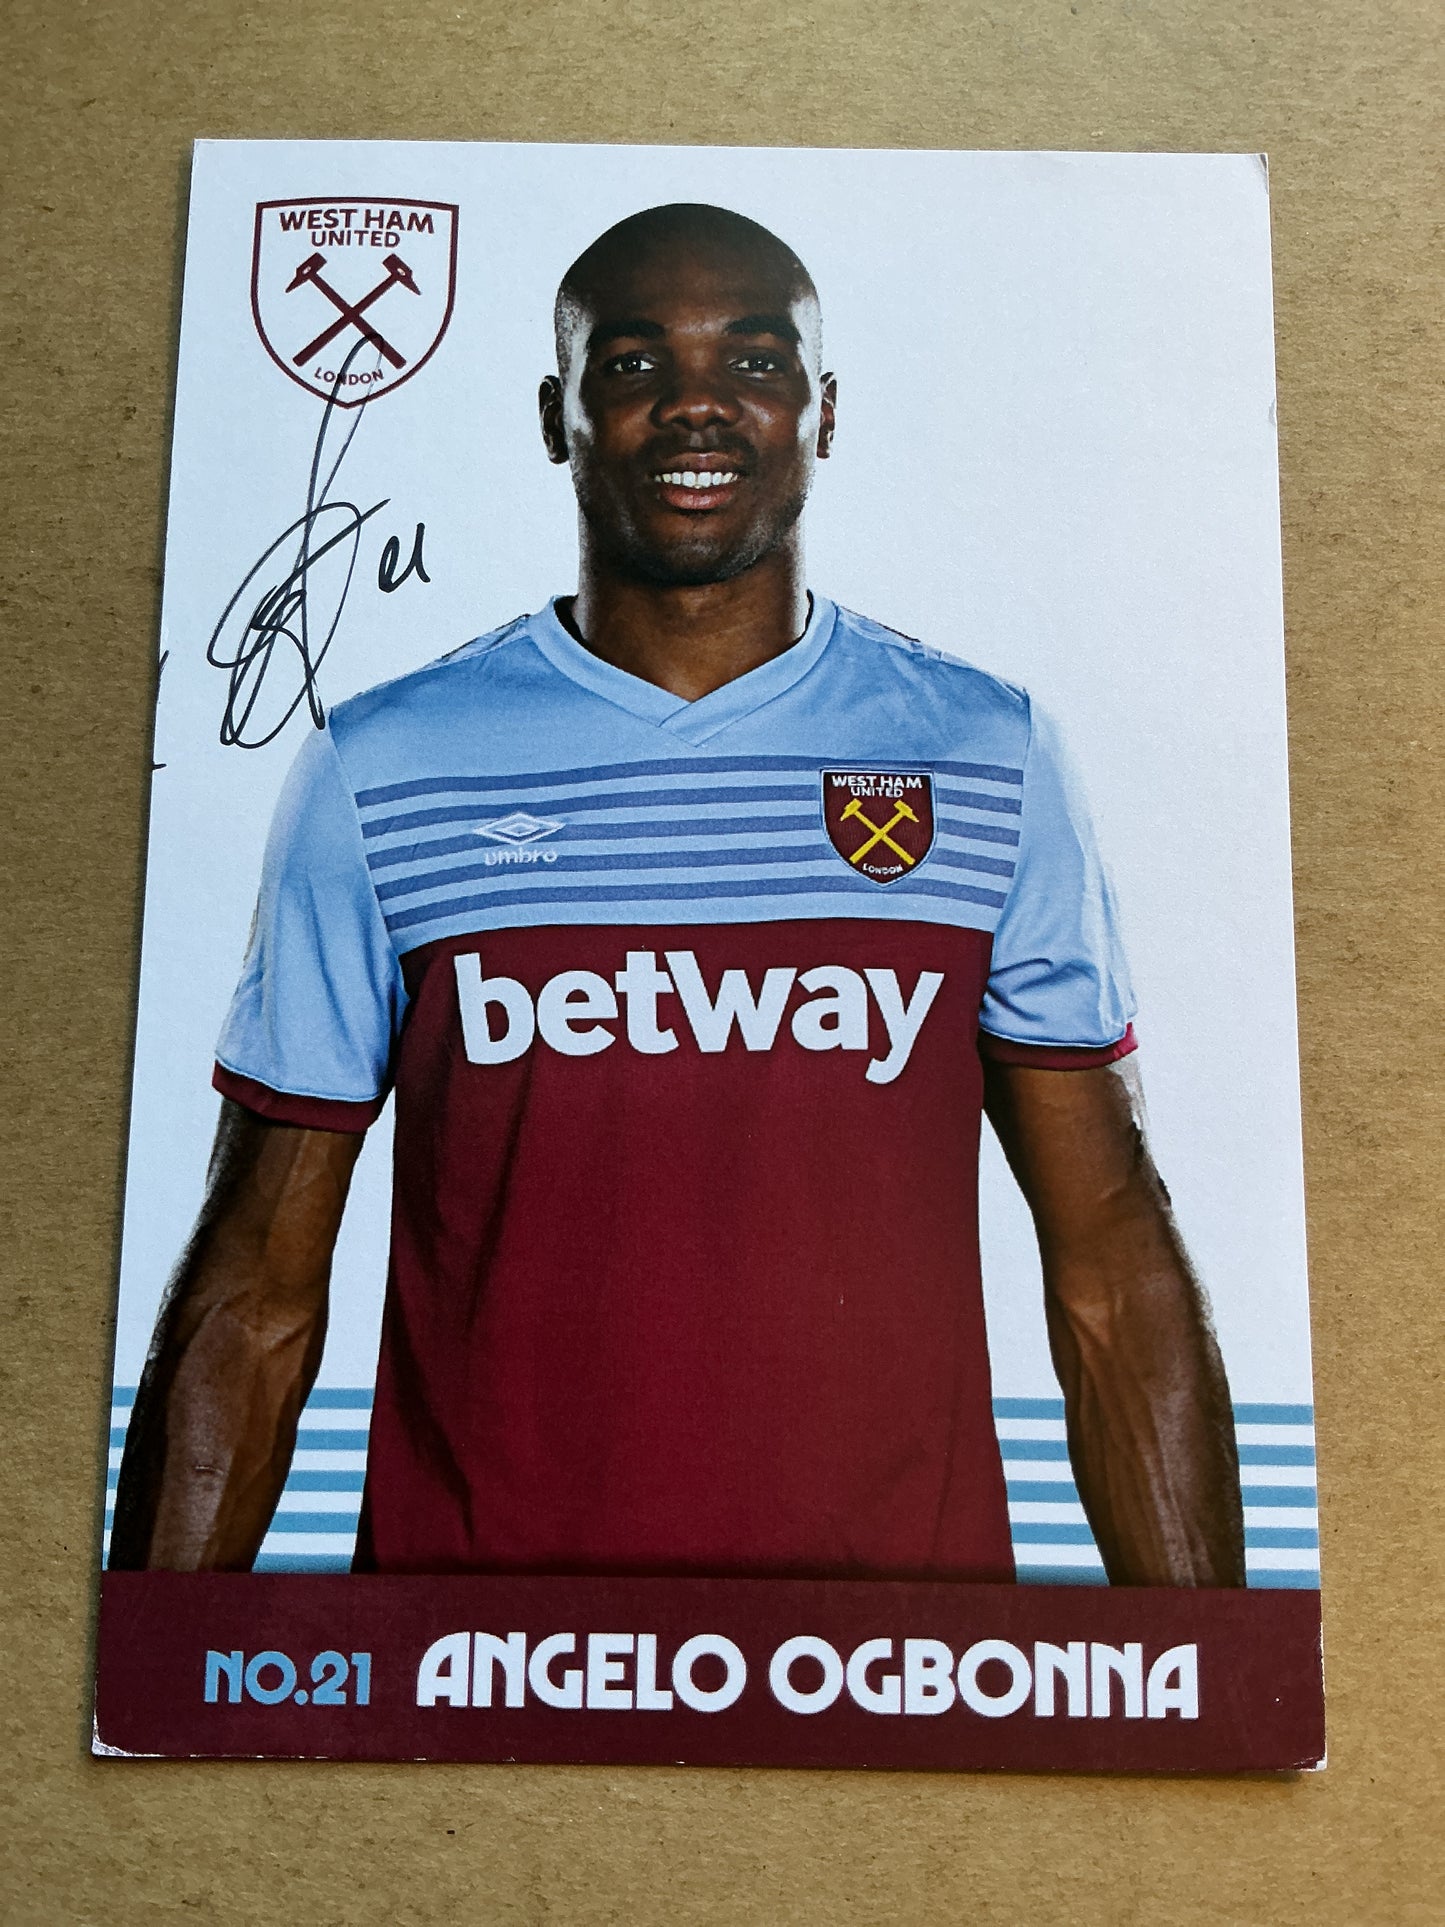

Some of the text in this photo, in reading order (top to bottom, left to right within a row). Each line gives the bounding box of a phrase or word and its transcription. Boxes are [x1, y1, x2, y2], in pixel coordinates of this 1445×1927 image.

[279, 208, 435, 234] WEST HAM
[311, 230, 400, 248] UNITED
[831, 775, 923, 789] WEST HAM
[850, 786, 904, 798] UNITED
[484, 846, 558, 866] umbro
[862, 862, 904, 876] LONDON
[453, 950, 945, 1085] betway
[204, 1631, 1199, 1719] NO.21 ANGELO OGBONNA
